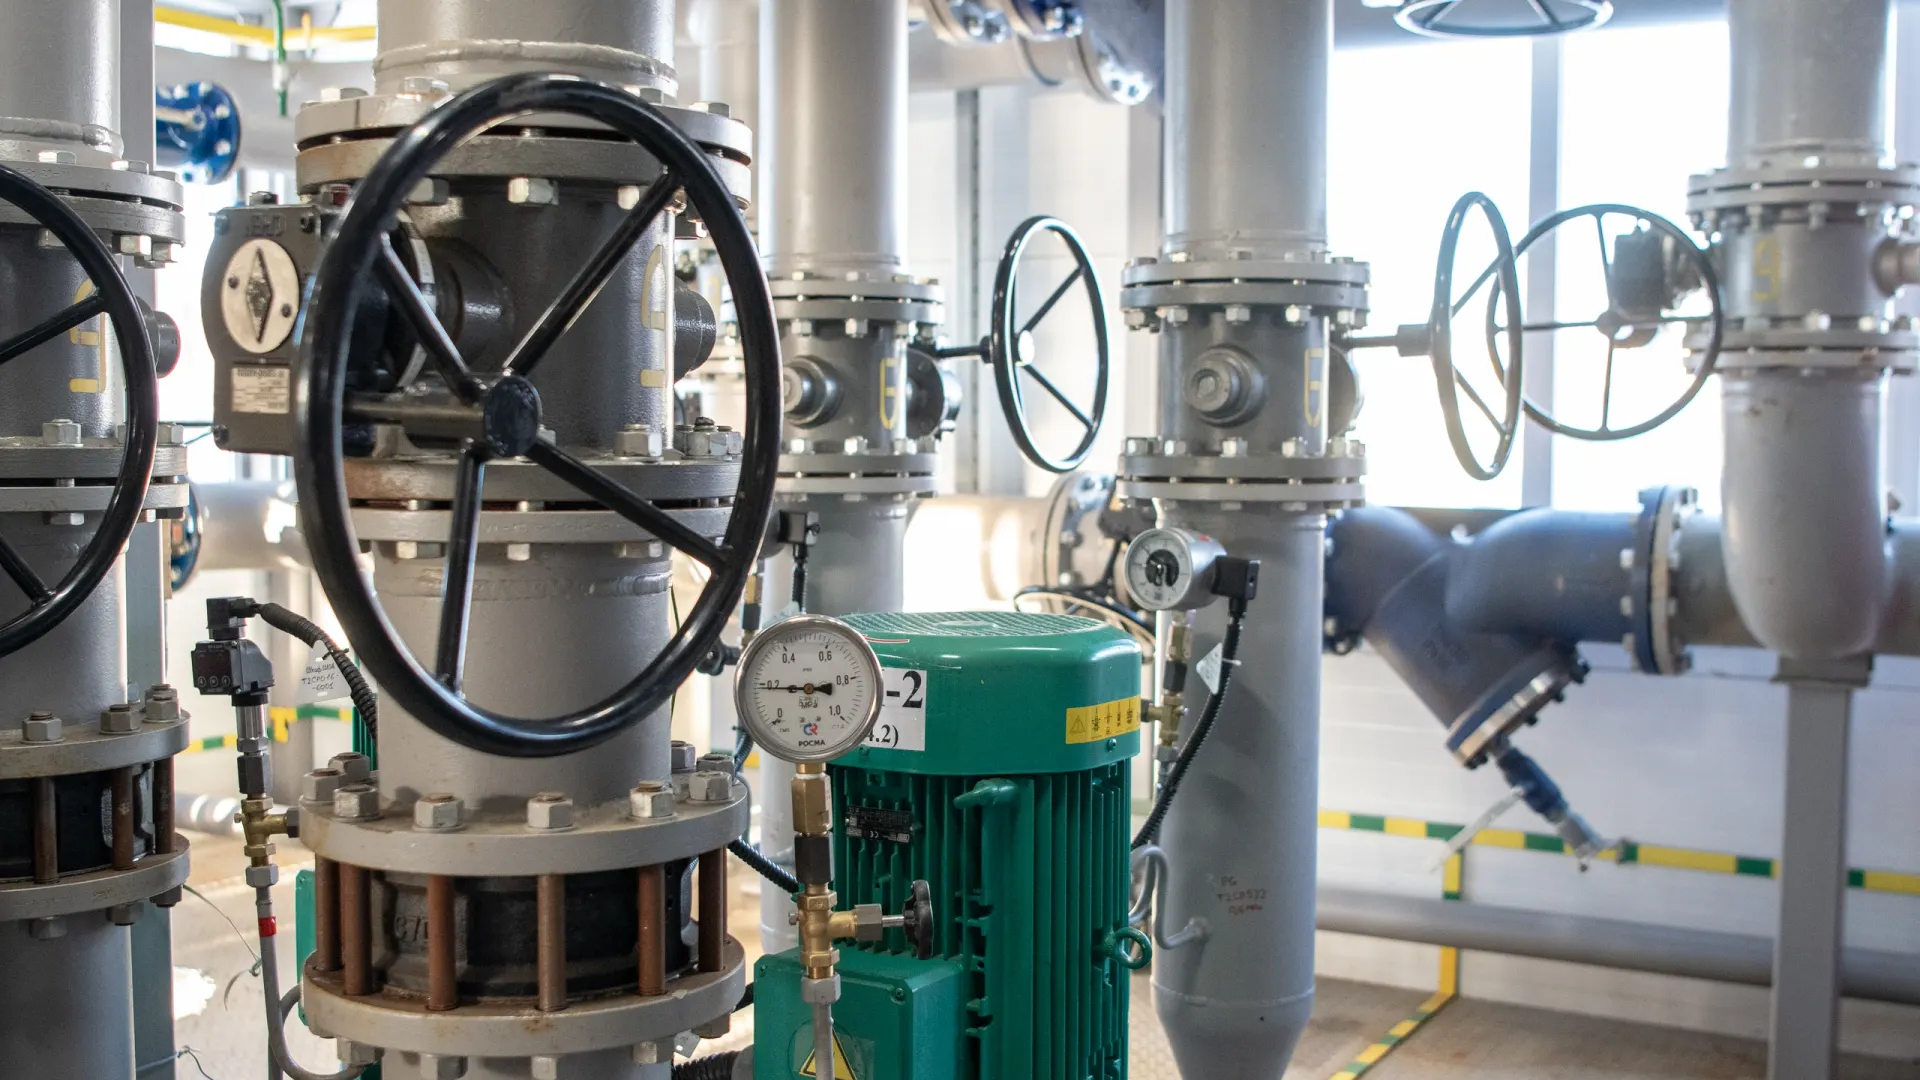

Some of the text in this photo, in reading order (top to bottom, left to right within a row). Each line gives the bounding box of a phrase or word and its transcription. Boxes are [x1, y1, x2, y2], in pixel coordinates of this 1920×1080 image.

[782, 652, 796, 664] 0,4
[818, 650, 832, 662] 0,6
[836, 674, 850, 686] 0,8
[777, 707, 783, 718] 0
[829, 704, 841, 716] 1,0
